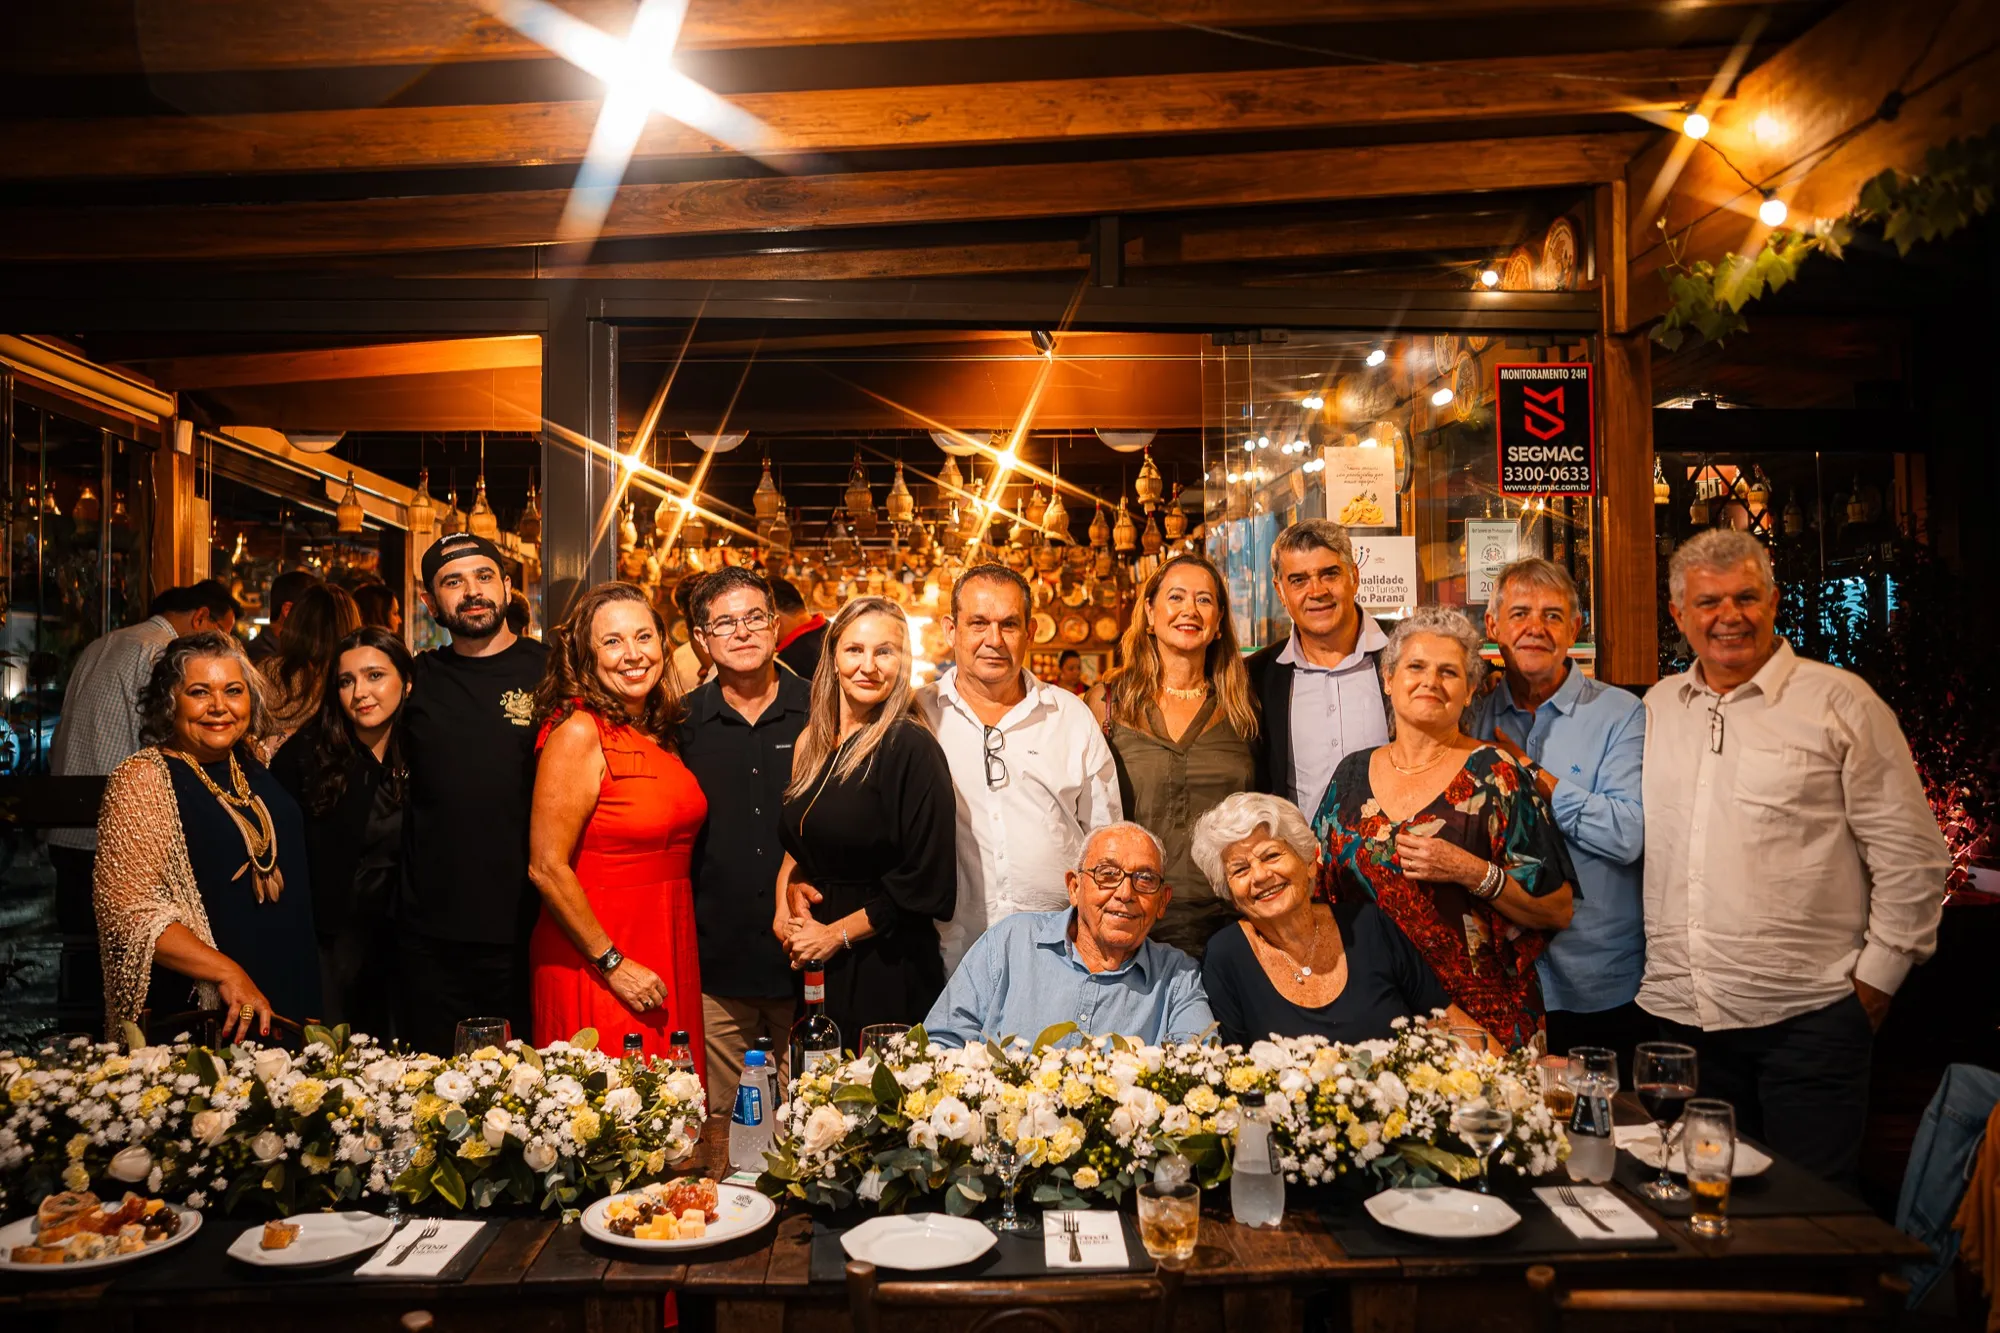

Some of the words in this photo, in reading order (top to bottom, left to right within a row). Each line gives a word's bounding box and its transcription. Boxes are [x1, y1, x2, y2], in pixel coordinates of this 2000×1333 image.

[1501, 368, 1569, 380] MONITORAMENTO
[1571, 368, 1587, 379] 24H
[1508, 446, 1585, 462] SEGMAC
[1504, 466, 1590, 482] 3300-0633
[1504, 483, 1590, 493] www.segmac.com.br
[1360, 575, 1404, 585] ualidade
[1363, 585, 1375, 593] no
[1376, 585, 1409, 594] Turismo
[1354, 593, 1367, 603] do
